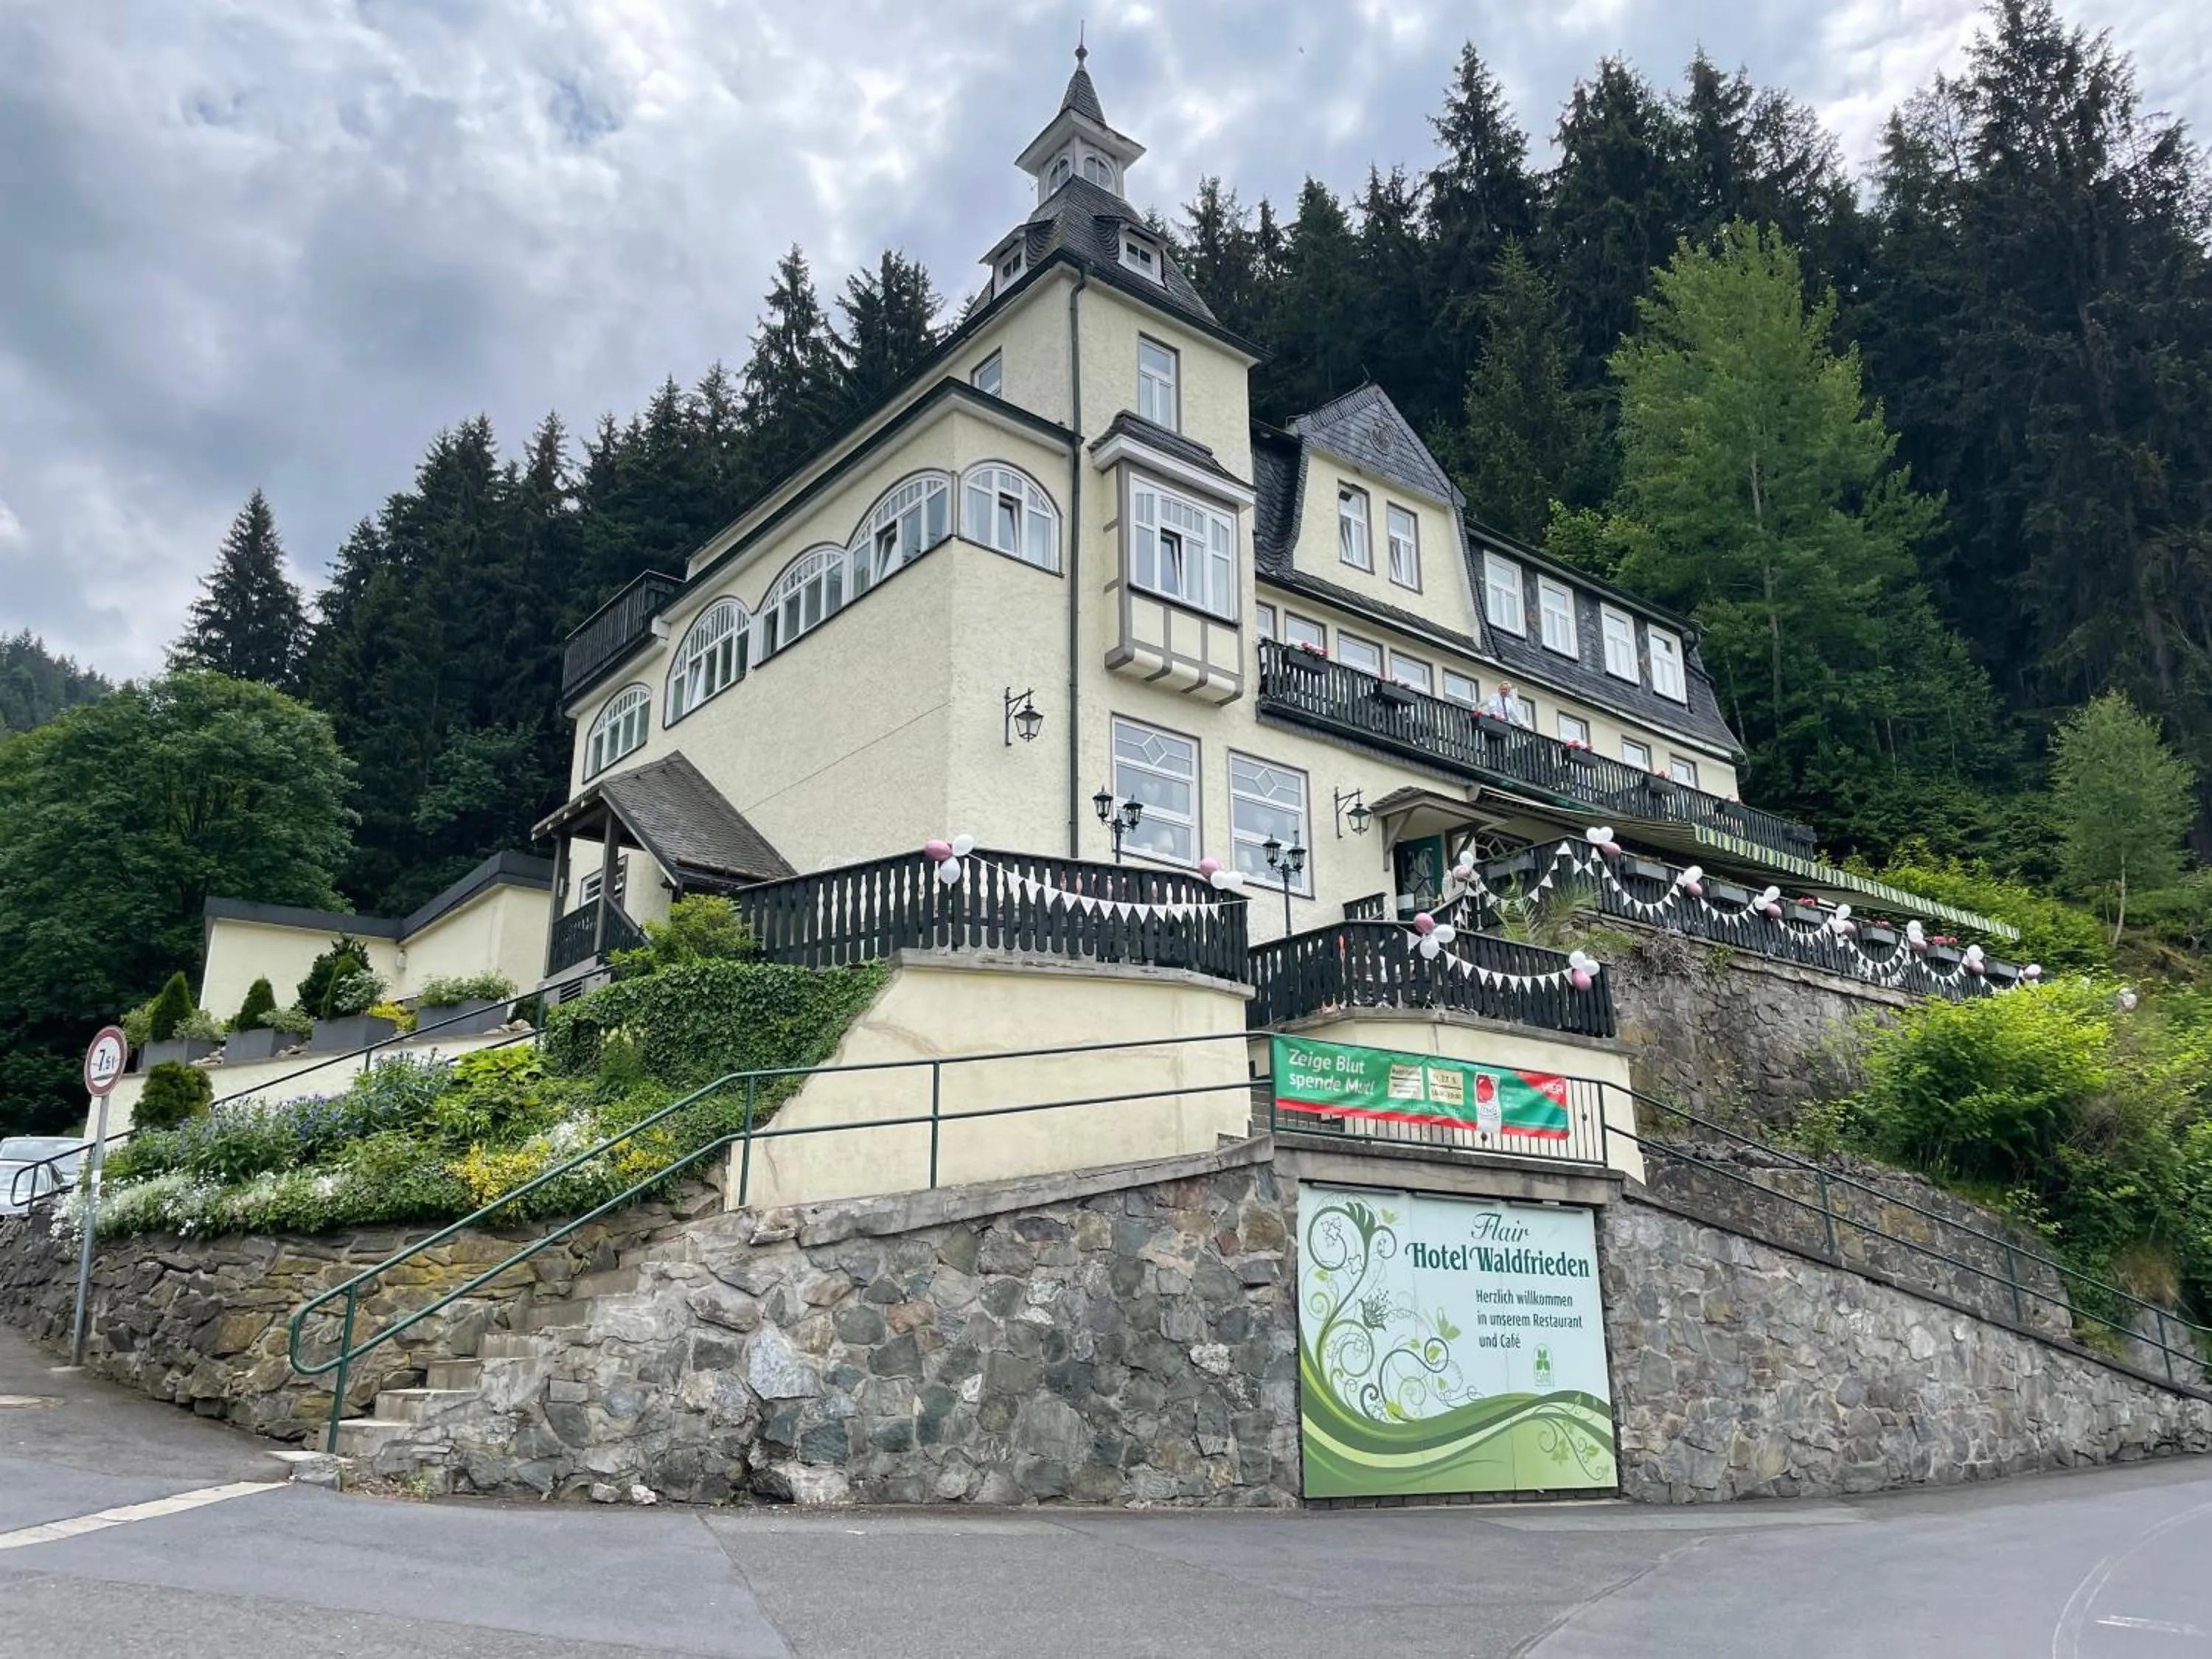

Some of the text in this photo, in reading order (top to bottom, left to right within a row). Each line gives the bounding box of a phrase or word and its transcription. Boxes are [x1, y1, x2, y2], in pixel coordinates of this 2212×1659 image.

[1288, 1048, 1365, 1074] Zeige Blut
[1289, 1073, 1341, 1092] spende
[1345, 1077, 1375, 1096] Mut!
[1471, 1212, 1529, 1242] Flair
[1405, 1242, 1590, 1278] Hotel Waldfrieden
[1475, 1289, 1573, 1307] Herzlich willkommen
[1477, 1310, 1583, 1328] in unserem Restaurant
[1478, 1332, 1521, 1349] und Café
